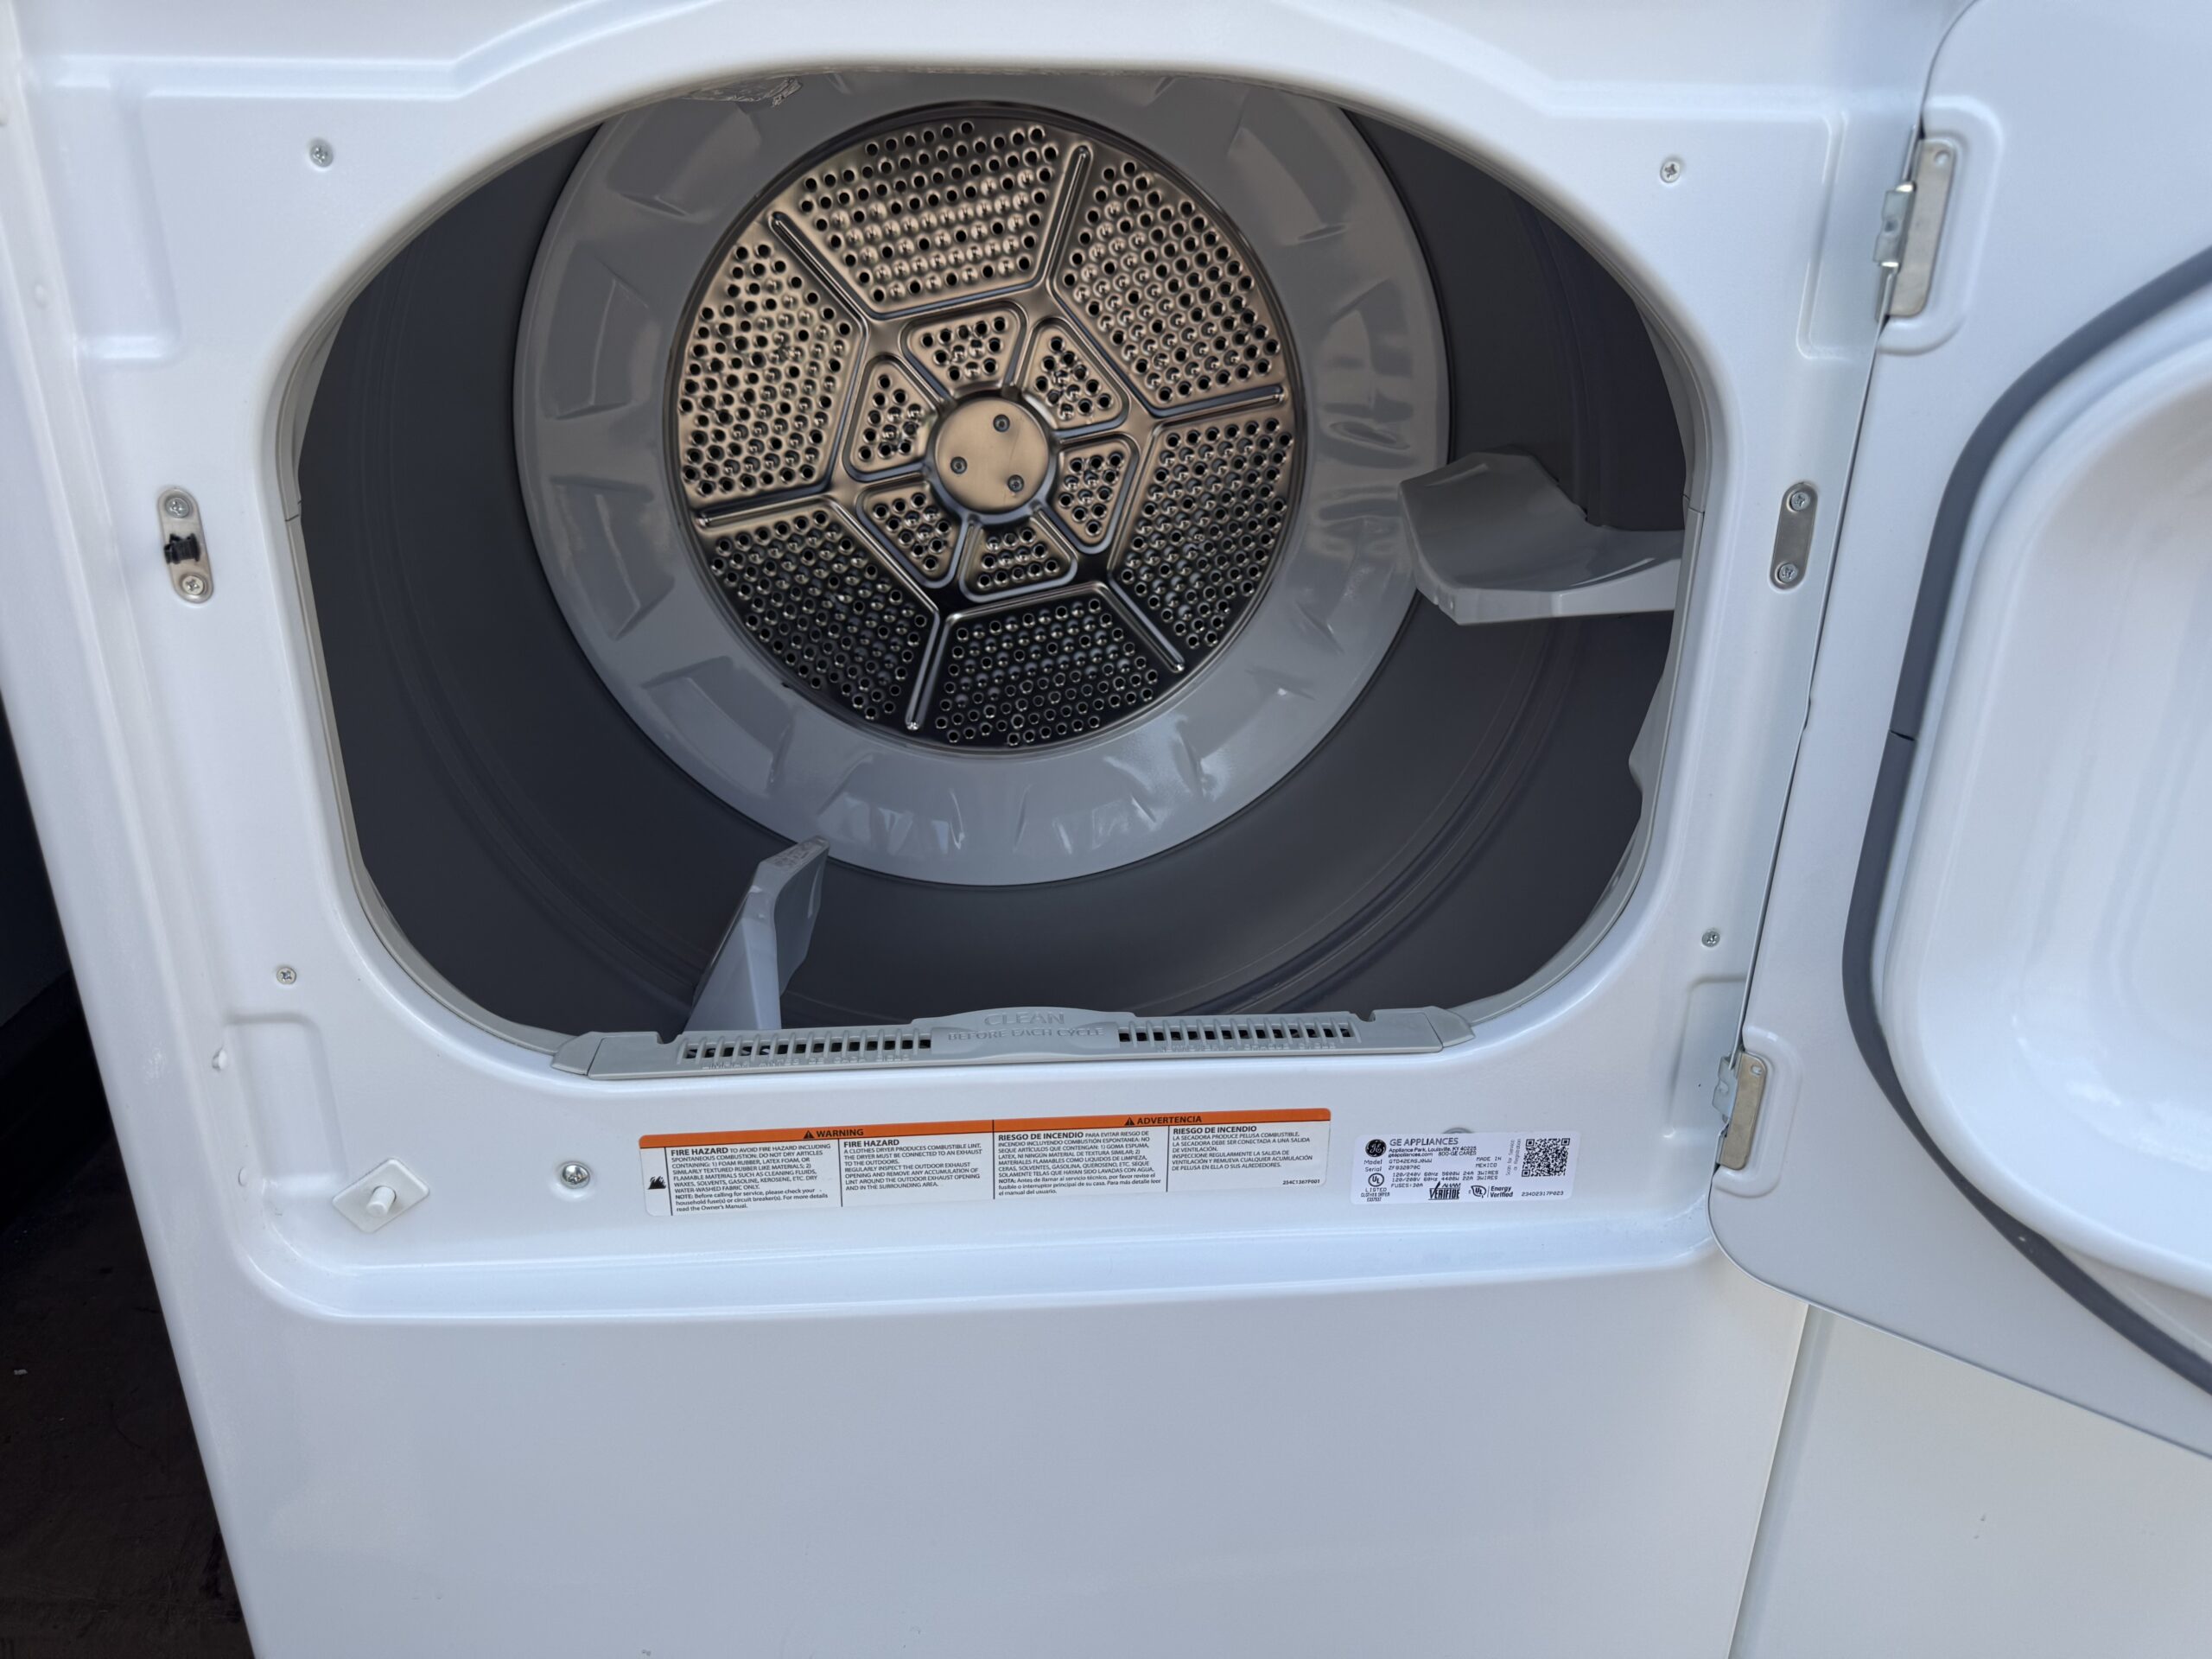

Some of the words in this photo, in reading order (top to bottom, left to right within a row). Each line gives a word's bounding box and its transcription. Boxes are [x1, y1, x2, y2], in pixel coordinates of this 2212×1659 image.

[984, 1011, 1065, 1027] CLEAN
[948, 1029, 1008, 1041] BEFORE
[1011, 1028, 1052, 1038] EACH
[1057, 1027, 1104, 1037] CYCLE
[1137, 1116, 1202, 1125] ADVERTENCIA
[816, 1128, 864, 1137] WARNING
[1389, 1138, 1402, 1147] GE
[1403, 1137, 1459, 1146] APPLIANCES
[690, 1147, 728, 1155] HAZARD
